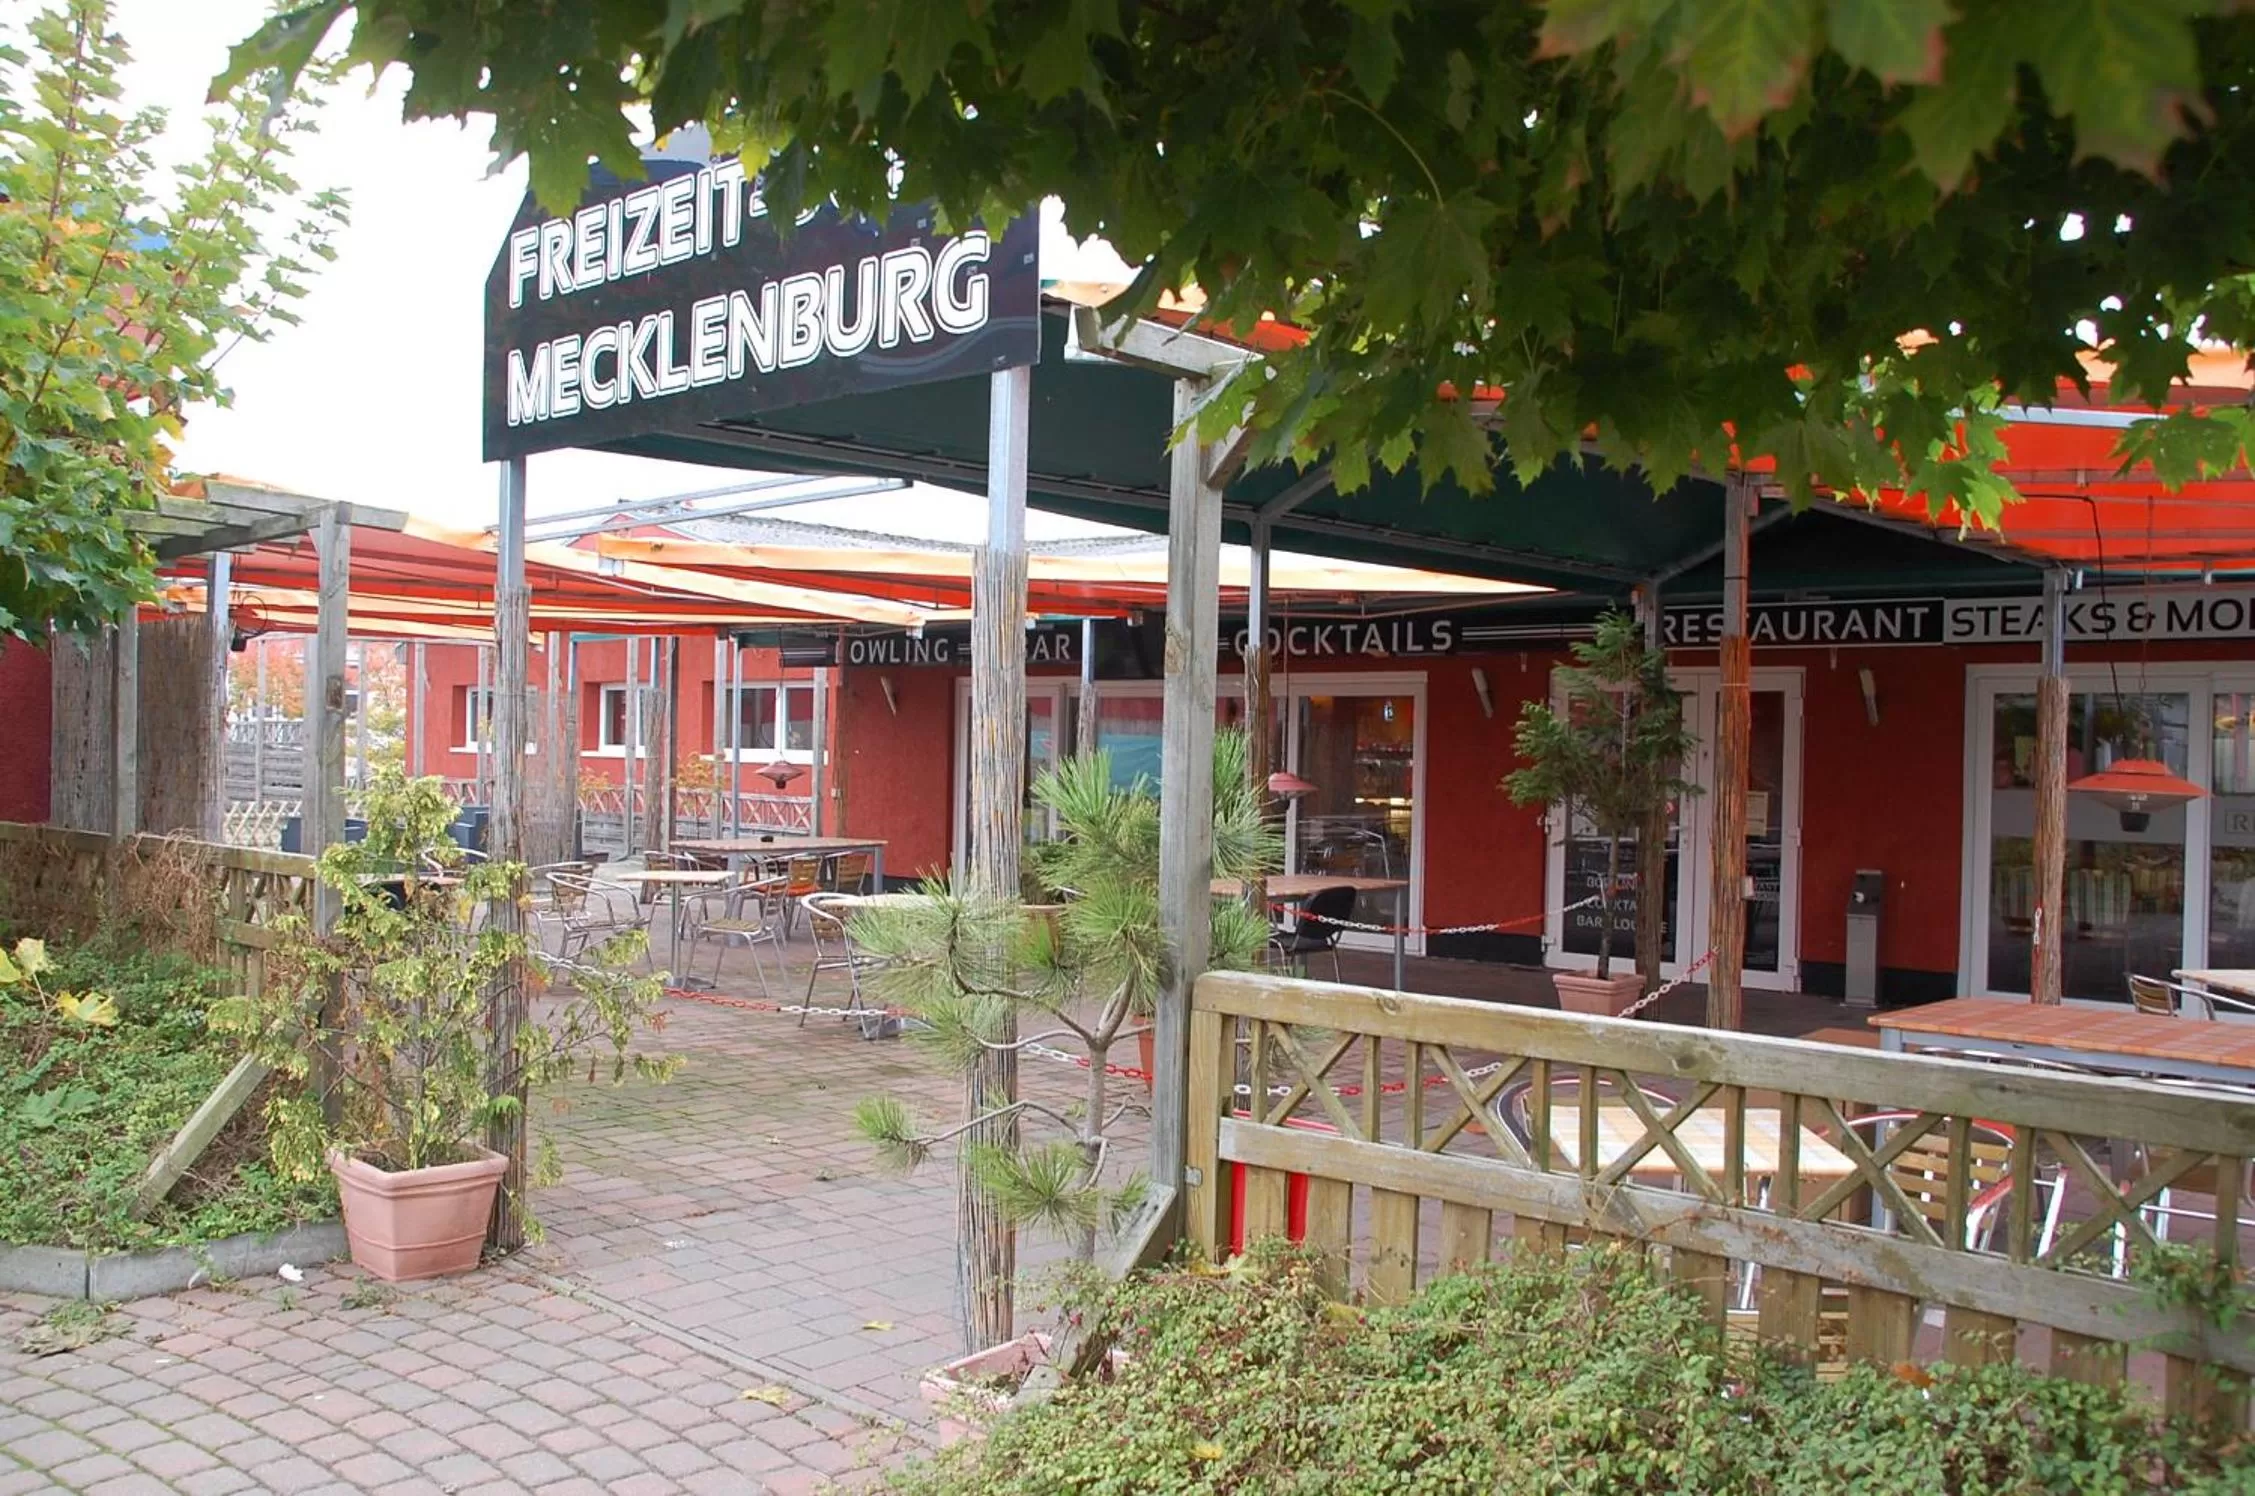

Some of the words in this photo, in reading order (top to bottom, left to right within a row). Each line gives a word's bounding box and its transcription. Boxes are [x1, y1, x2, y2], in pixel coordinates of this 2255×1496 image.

[507, 229, 991, 427] MECKLENBURG
[1663, 607, 1930, 643] RESAURANT
[2127, 602, 2156, 633] &
[2166, 598, 2255, 633] MO
[1025, 633, 1072, 661] AR
[1576, 914, 1603, 929] BAR
